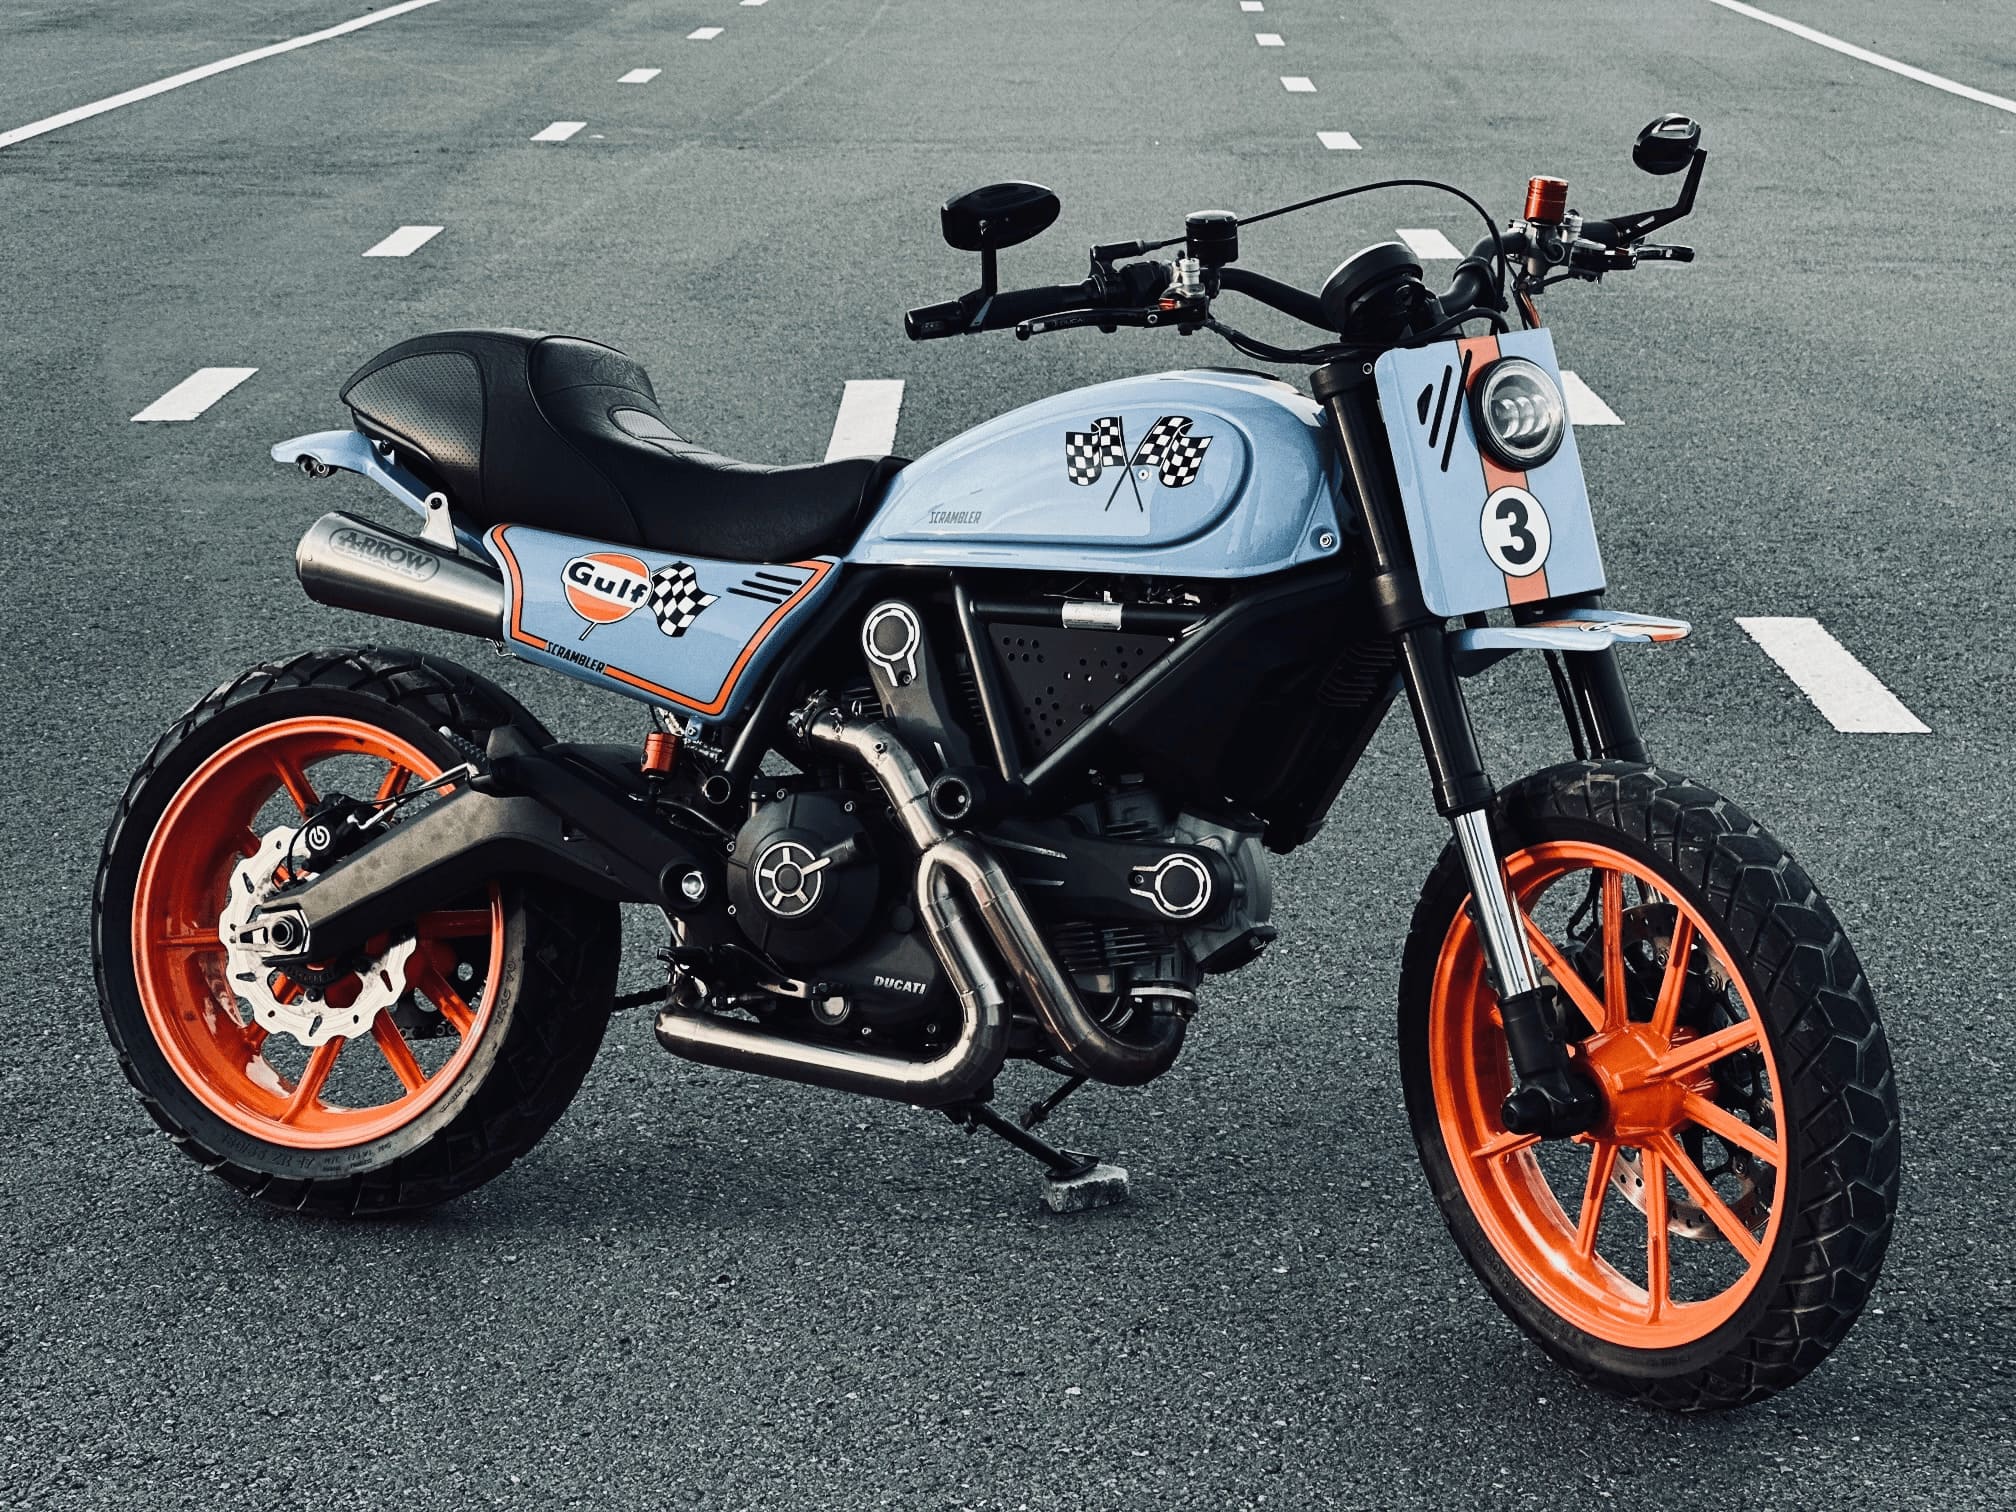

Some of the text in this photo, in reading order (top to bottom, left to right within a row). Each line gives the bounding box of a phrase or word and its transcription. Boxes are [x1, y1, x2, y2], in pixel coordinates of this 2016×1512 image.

[928, 511, 983, 524] SCRAMBLER
[1495, 497, 1537, 565] 3
[338, 531, 433, 571] ARROW
[568, 561, 649, 603] Gulf
[546, 640, 605, 673] SCRAMBLER
[873, 975, 927, 995] DUCATI
